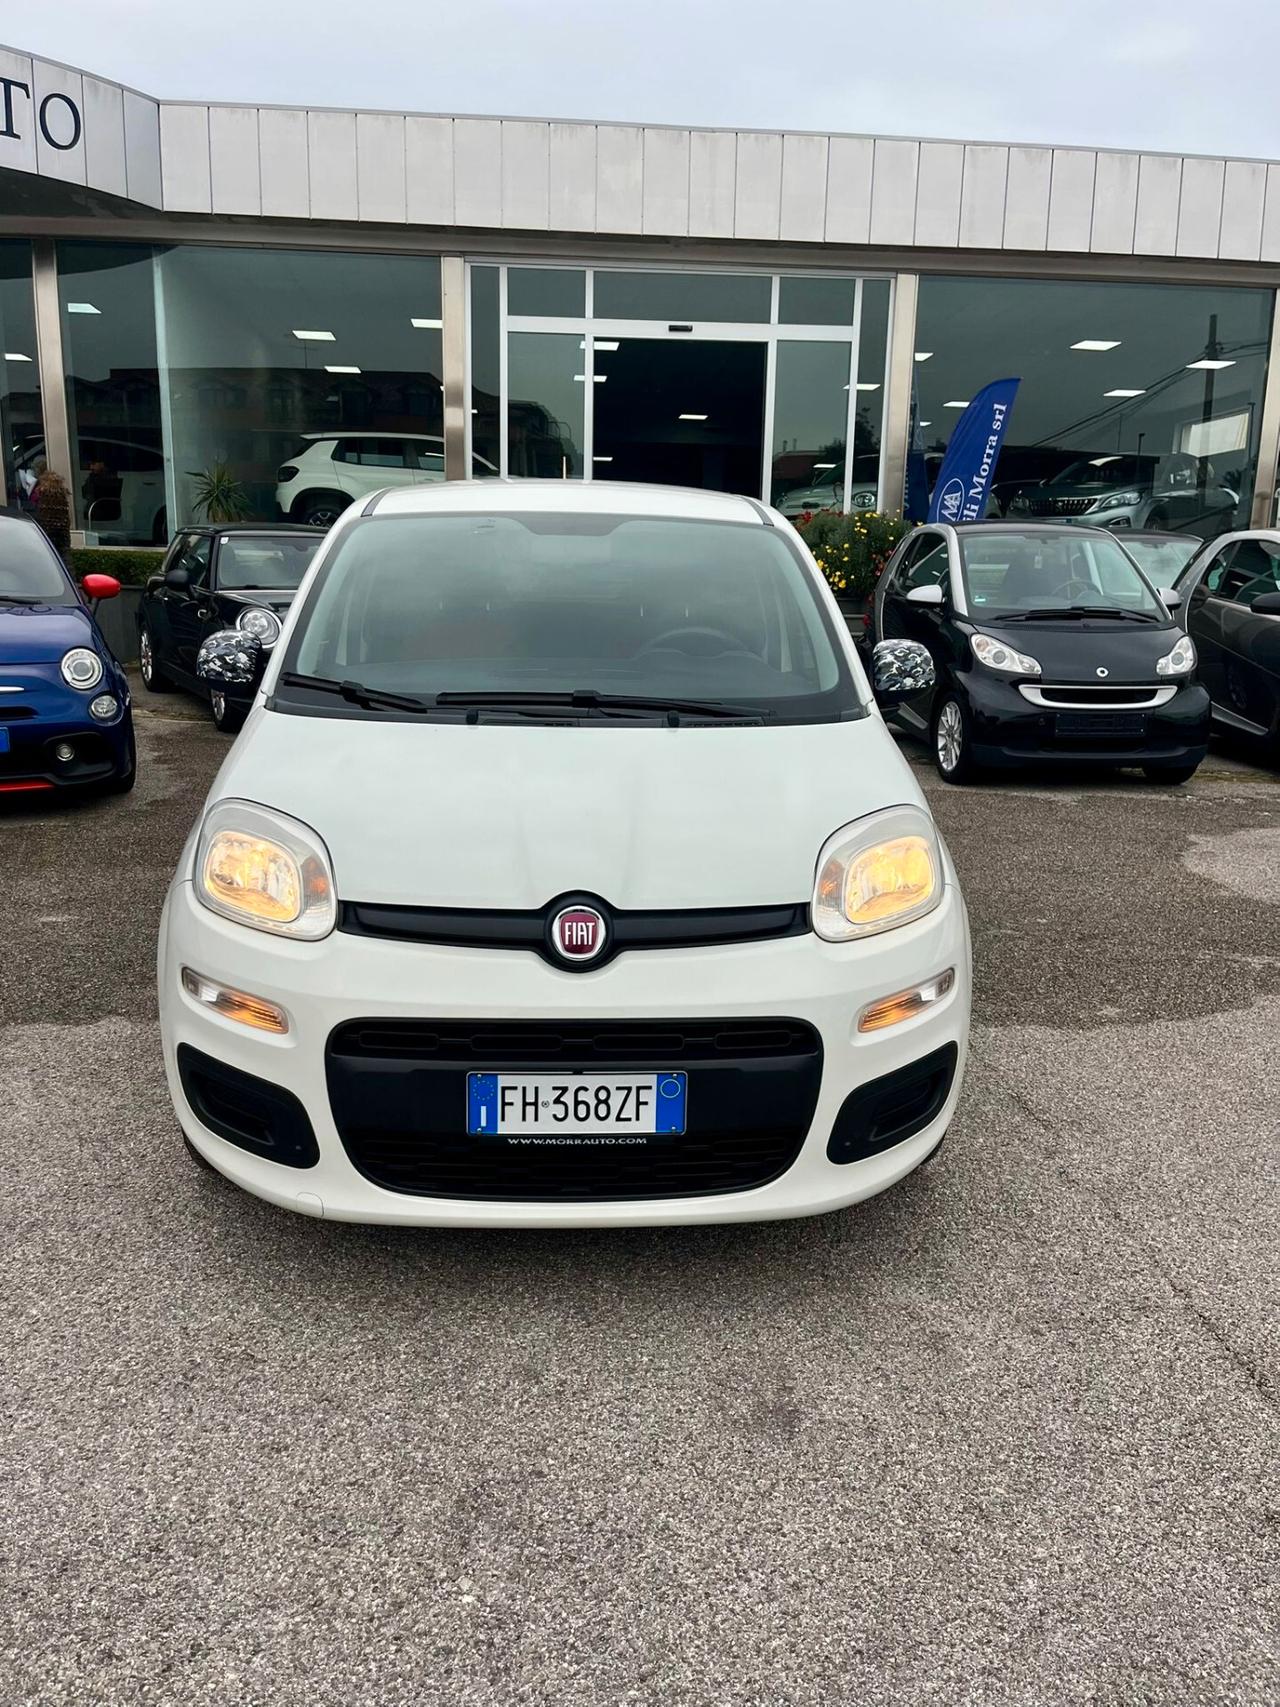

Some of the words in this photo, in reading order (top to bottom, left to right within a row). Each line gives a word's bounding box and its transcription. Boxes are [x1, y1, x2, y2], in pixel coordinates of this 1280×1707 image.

[969, 435, 999, 501] Morra
[992, 403, 1008, 431] srl
[564, 921, 596, 946] FIAT
[507, 1137, 648, 1145] WWW.MORRAUTO.COM
